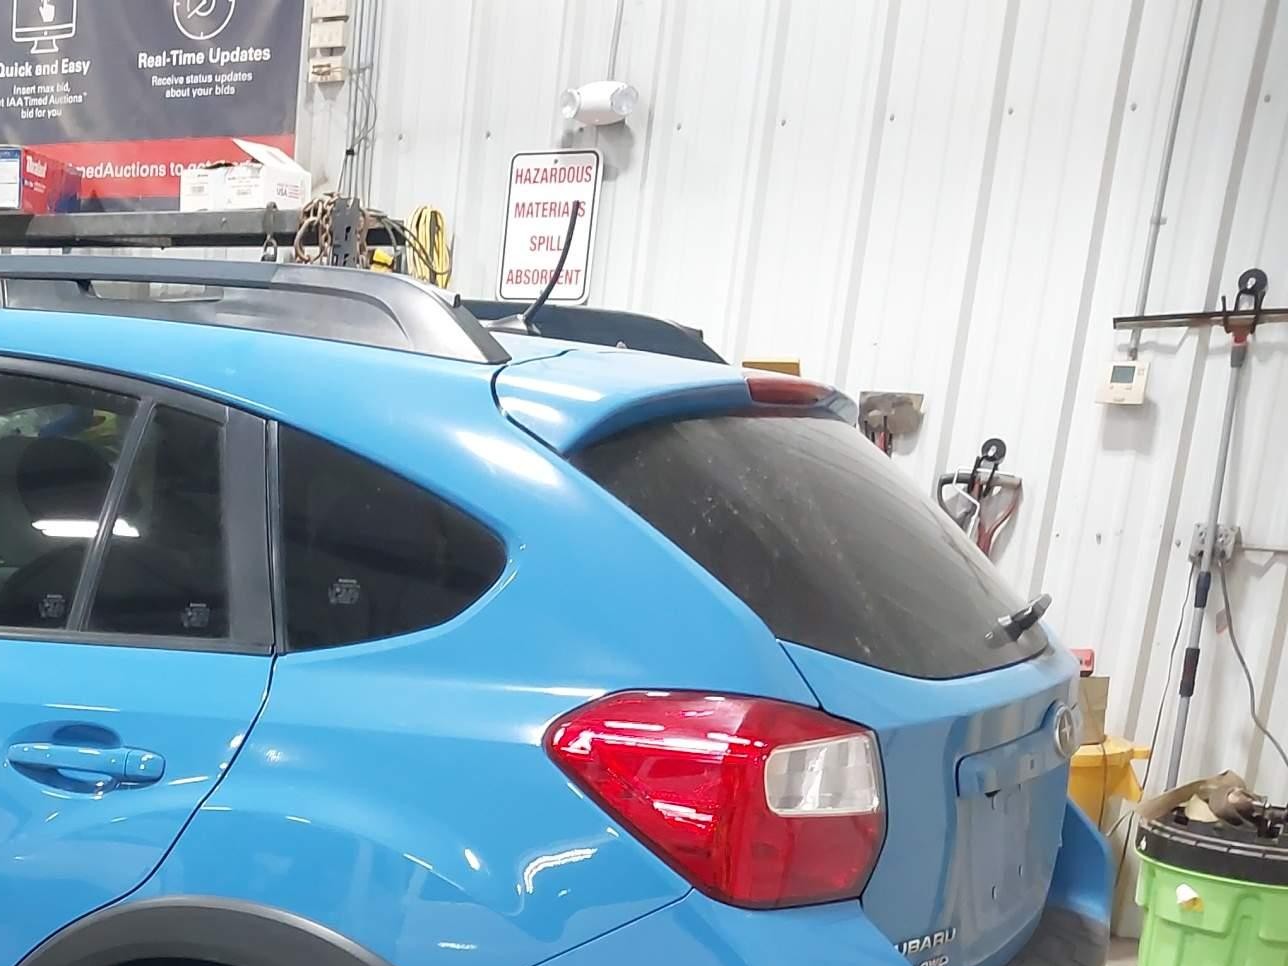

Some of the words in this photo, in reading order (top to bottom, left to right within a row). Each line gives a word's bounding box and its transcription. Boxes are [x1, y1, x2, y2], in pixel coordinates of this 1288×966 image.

[35, 59, 59, 76] and
[61, 57, 91, 76] Easy
[138, 49, 205, 69] Real-Time
[208, 46, 271, 66] Updates
[151, 74, 184, 87] Receive
[185, 73, 213, 84] status
[214, 71, 253, 84] updates
[13, 84, 36, 96] Insert
[37, 85, 55, 94] max
[165, 87, 190, 98] about
[192, 86, 213, 98] your
[214, 84, 236, 95] bids
[20, 107, 34, 119] bid
[35, 106, 46, 118] for
[47, 108, 63, 119] you
[68, 160, 167, 180] medAuctions
[169, 161, 184, 177] to
[515, 166, 593, 185] HAZARDOUS
[514, 200, 586, 219] MATERIAS
[529, 235, 564, 252] SPILL
